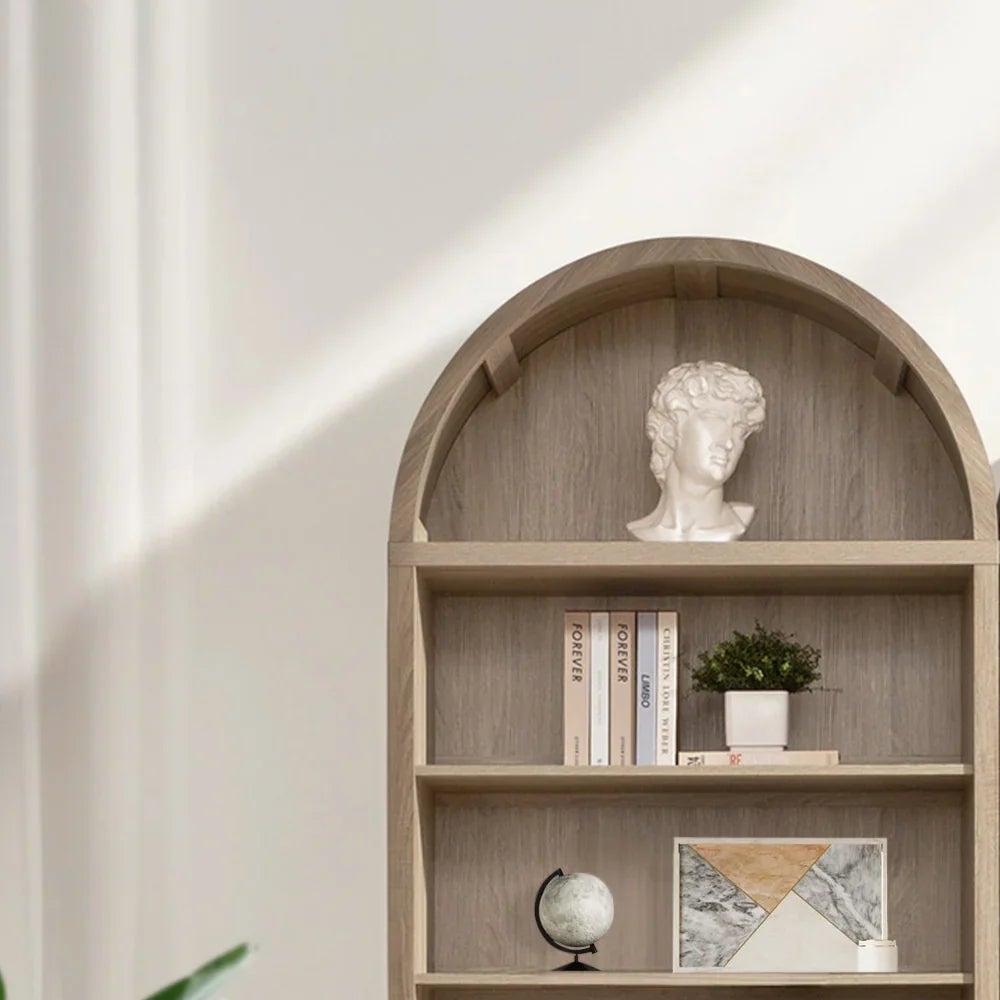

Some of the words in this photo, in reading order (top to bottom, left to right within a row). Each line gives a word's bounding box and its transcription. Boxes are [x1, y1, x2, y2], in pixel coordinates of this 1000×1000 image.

[571, 623, 583, 683] FOREVER
[617, 623, 629, 683] FOREVER
[641, 674, 651, 708] LIMBO
